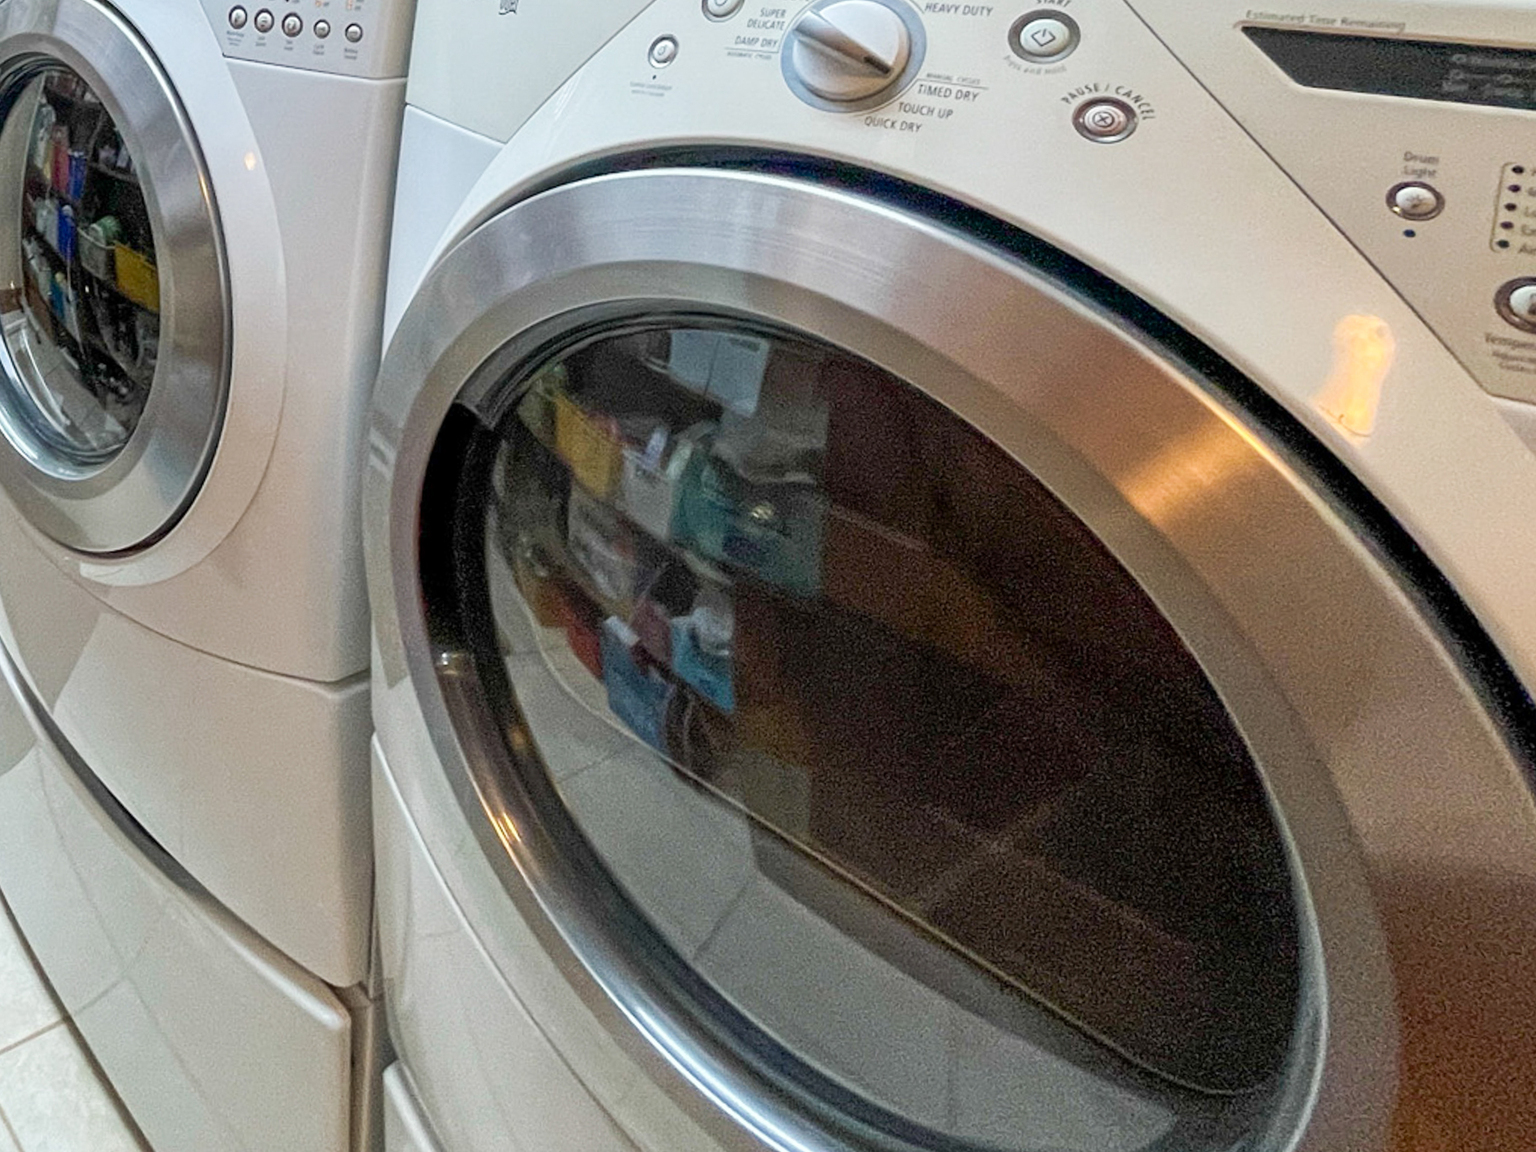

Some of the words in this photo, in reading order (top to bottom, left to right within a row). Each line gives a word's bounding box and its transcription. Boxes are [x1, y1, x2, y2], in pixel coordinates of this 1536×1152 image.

[760, 7, 787, 19] SUPER
[924, 2, 960, 15] HEAVY
[963, 4, 994, 17] DUTY
[1246, 9, 1305, 24] Estimated
[1309, 14, 1337, 26] Time
[747, 18, 786, 31] DELICATE
[734, 35, 759, 47] DAMP
[760, 37, 780, 49] DRY
[917, 83, 952, 99] TIMED
[955, 88, 980, 102] DRY
[898, 101, 935, 116] TOUCH
[938, 107, 954, 120] UP
[1061, 83, 1101, 105] PAUSE
[1114, 85, 1157, 121] CANCEL
[864, 115, 897, 130] QUICK
[899, 120, 922, 133] DRY
